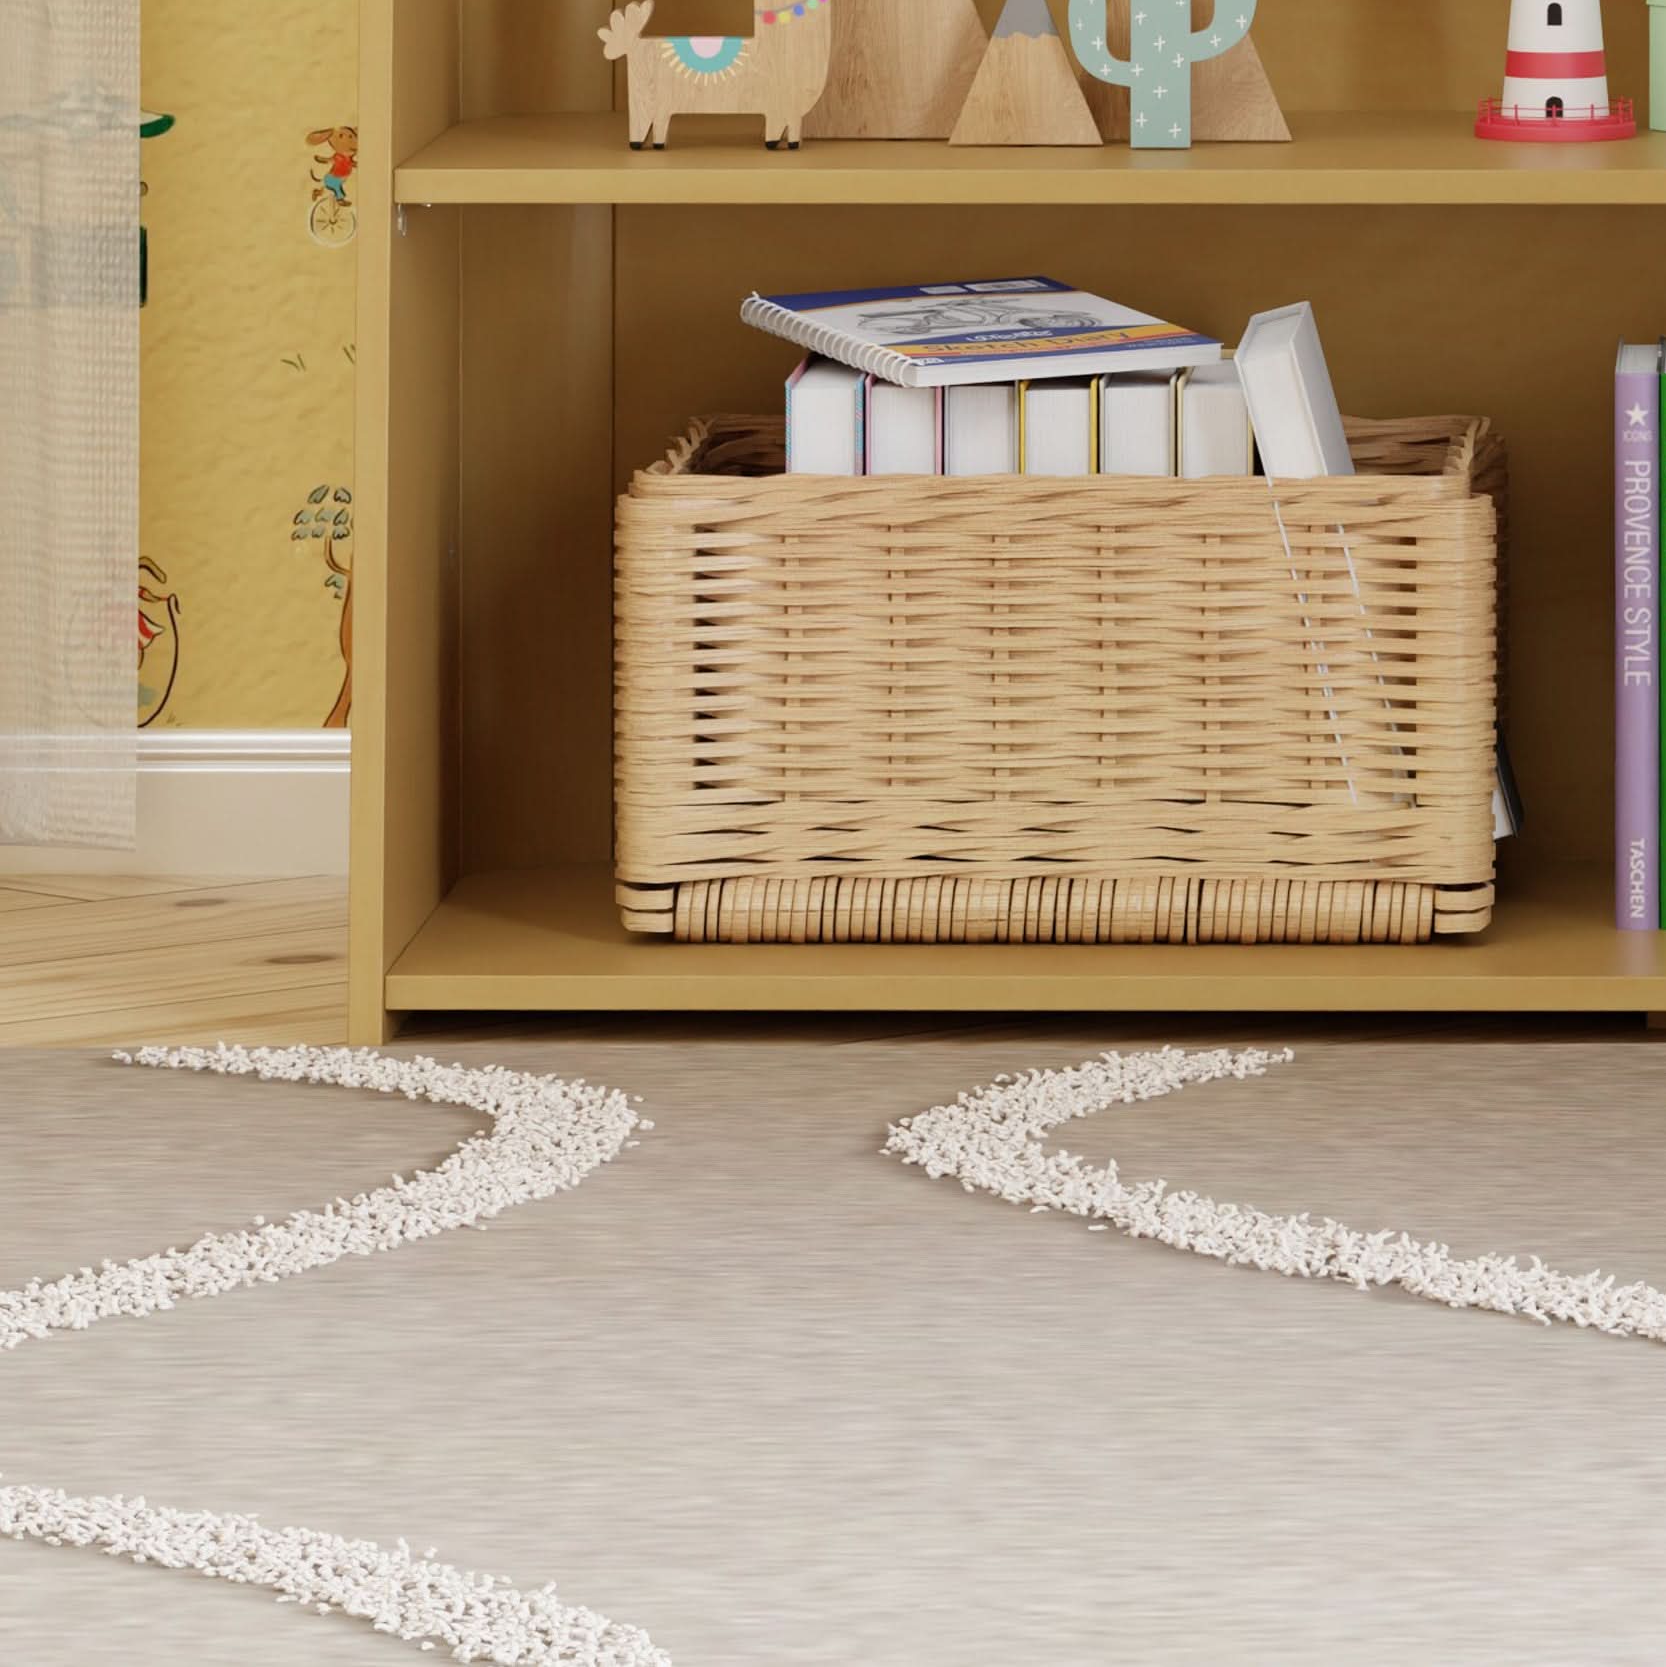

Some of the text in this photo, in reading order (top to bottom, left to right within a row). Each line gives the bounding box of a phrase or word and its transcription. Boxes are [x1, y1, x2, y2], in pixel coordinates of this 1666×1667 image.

[1623, 461, 1651, 686] PROVENCE STYLE
[1630, 837, 1645, 919] TASCHEN
